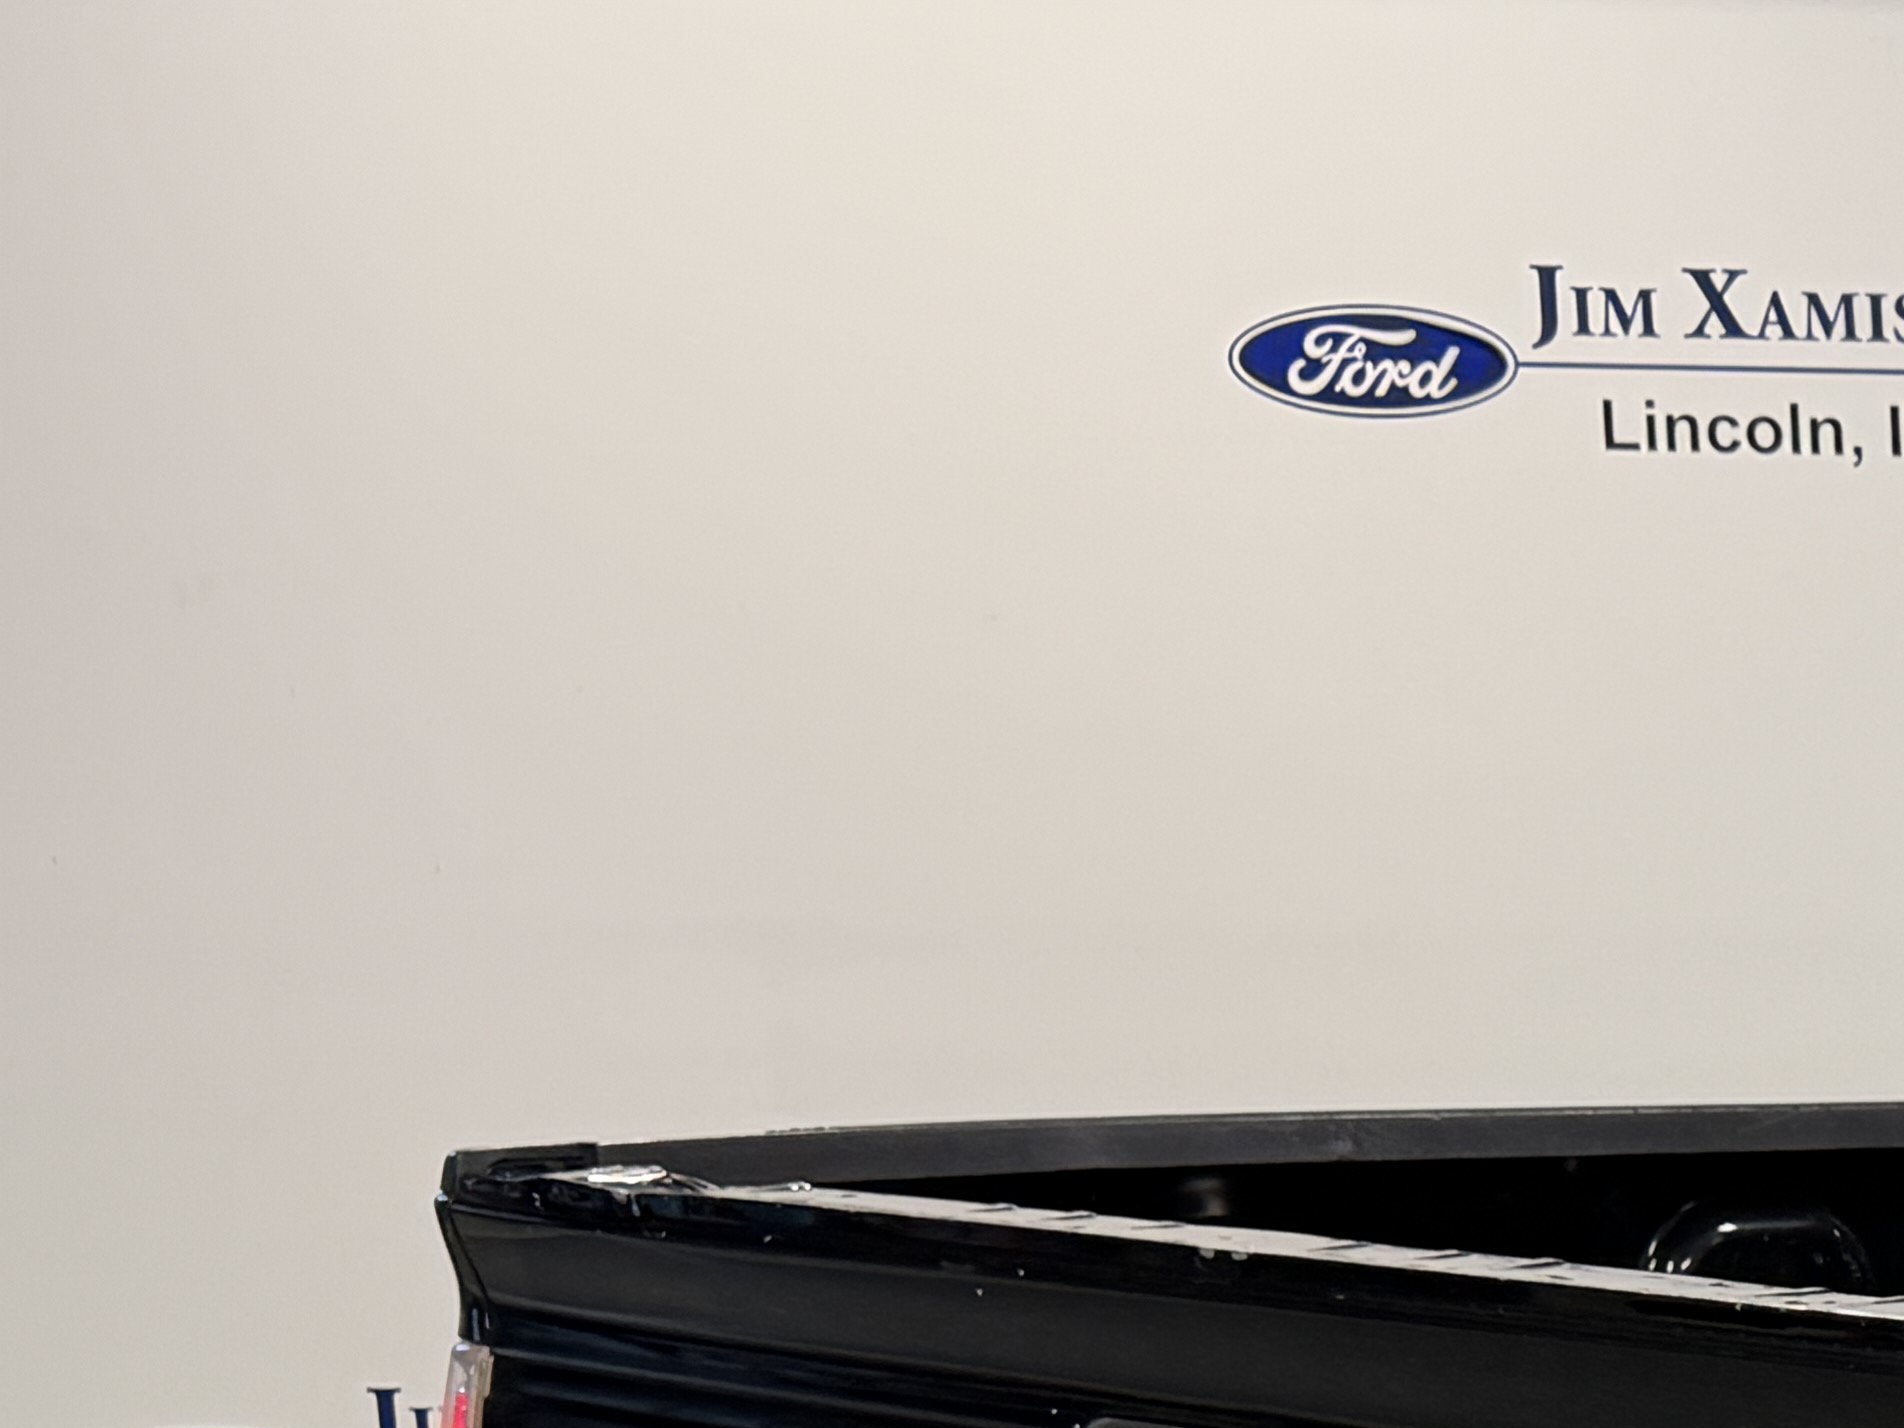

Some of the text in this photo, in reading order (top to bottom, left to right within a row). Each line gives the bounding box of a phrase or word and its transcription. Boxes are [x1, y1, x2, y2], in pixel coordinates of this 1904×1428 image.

[1529, 263, 1660, 350] JIM
[1285, 322, 1463, 401] Ford
[1600, 398, 1866, 470] Lincoln,
